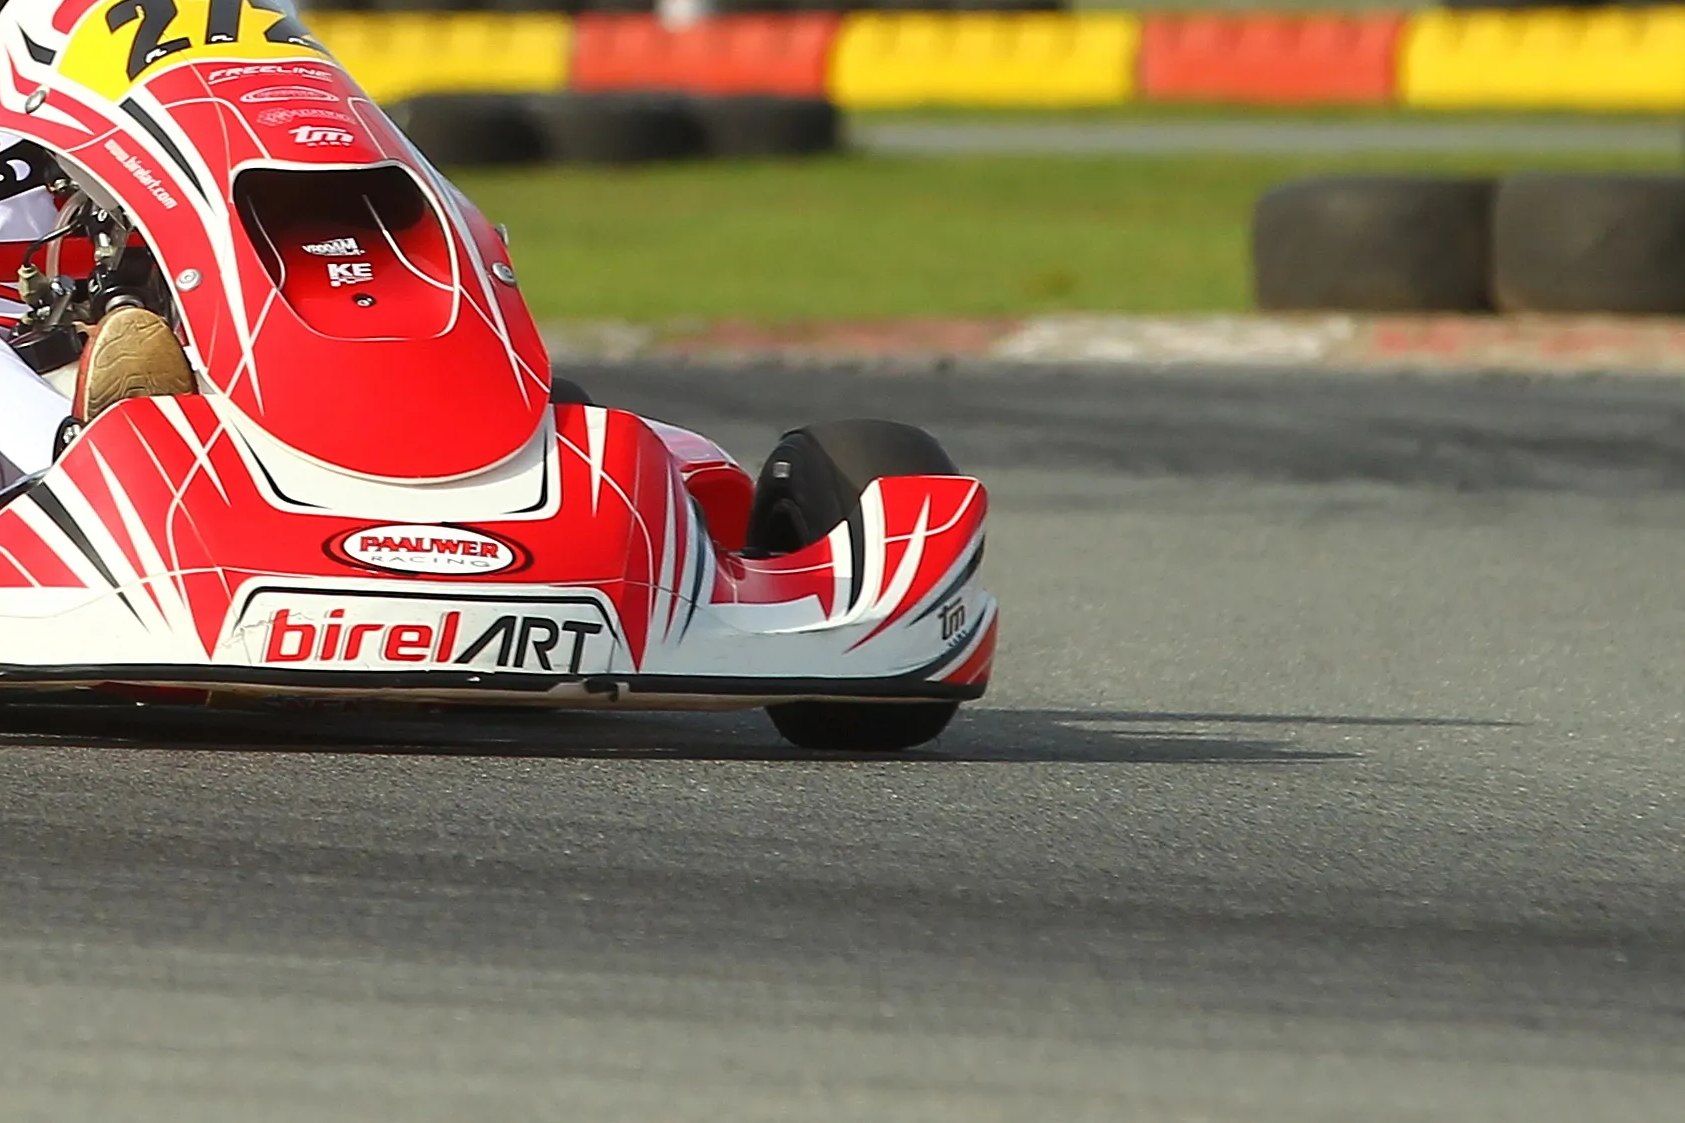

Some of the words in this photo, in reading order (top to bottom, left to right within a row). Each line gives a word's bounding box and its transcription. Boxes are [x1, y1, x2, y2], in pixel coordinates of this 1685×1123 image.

[208, 65, 332, 80] FREELINE
[369, 554, 492, 568] RACING
[264, 607, 603, 675] birelART
